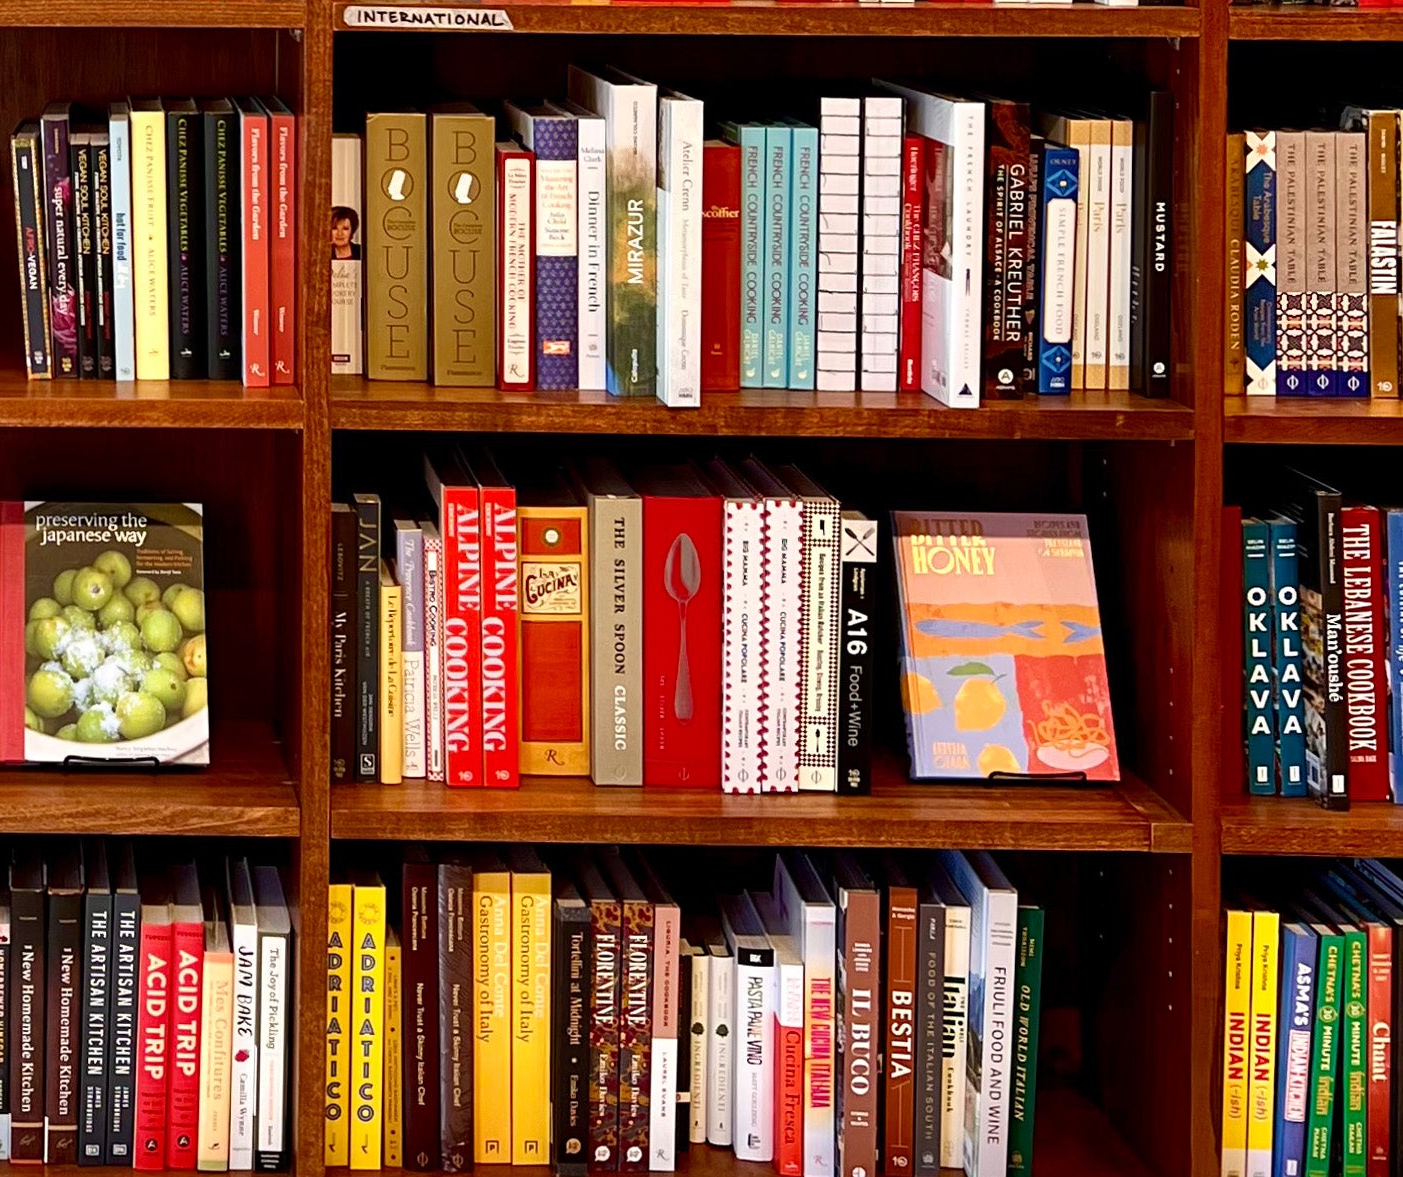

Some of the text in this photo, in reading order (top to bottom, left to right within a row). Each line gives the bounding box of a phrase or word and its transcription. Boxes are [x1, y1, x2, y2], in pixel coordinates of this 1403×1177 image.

[357, 10, 504, 26] INTERNATIONAL
[1348, 145, 1357, 166] THE
[587, 191, 601, 313] Dinner in French
[628, 199, 643, 285] MIRAZUR
[1005, 164, 1025, 342] GABRIEL KREUTHER
[1154, 201, 1165, 272] MUSTARD
[1348, 172, 1357, 246] PALESTINIAN
[1371, 221, 1396, 294] FALASTIN
[36, 514, 147, 530] preserving the
[40, 528, 147, 546] japanese way
[910, 547, 996, 575] HONEY
[446, 504, 481, 753] ALPINE COOKING
[614, 518, 626, 751] THE SILVER SPOON CLASSIC
[1246, 587, 1271, 735] OKLAVA
[1343, 524, 1377, 751] THE LEBANESE COOKBOOK
[175, 950, 198, 1077] ACID TRIP
[515, 895, 533, 1043] Gastronomy of Italy
[595, 935, 616, 1025] FLORENTINE
[357, 933, 376, 1122] ADRIATICO
[891, 990, 912, 1079] BESTIA
[988, 966, 1006, 1145] FRIULI FOOD AND WINE
[1255, 1014, 1271, 1081] INDIAN
